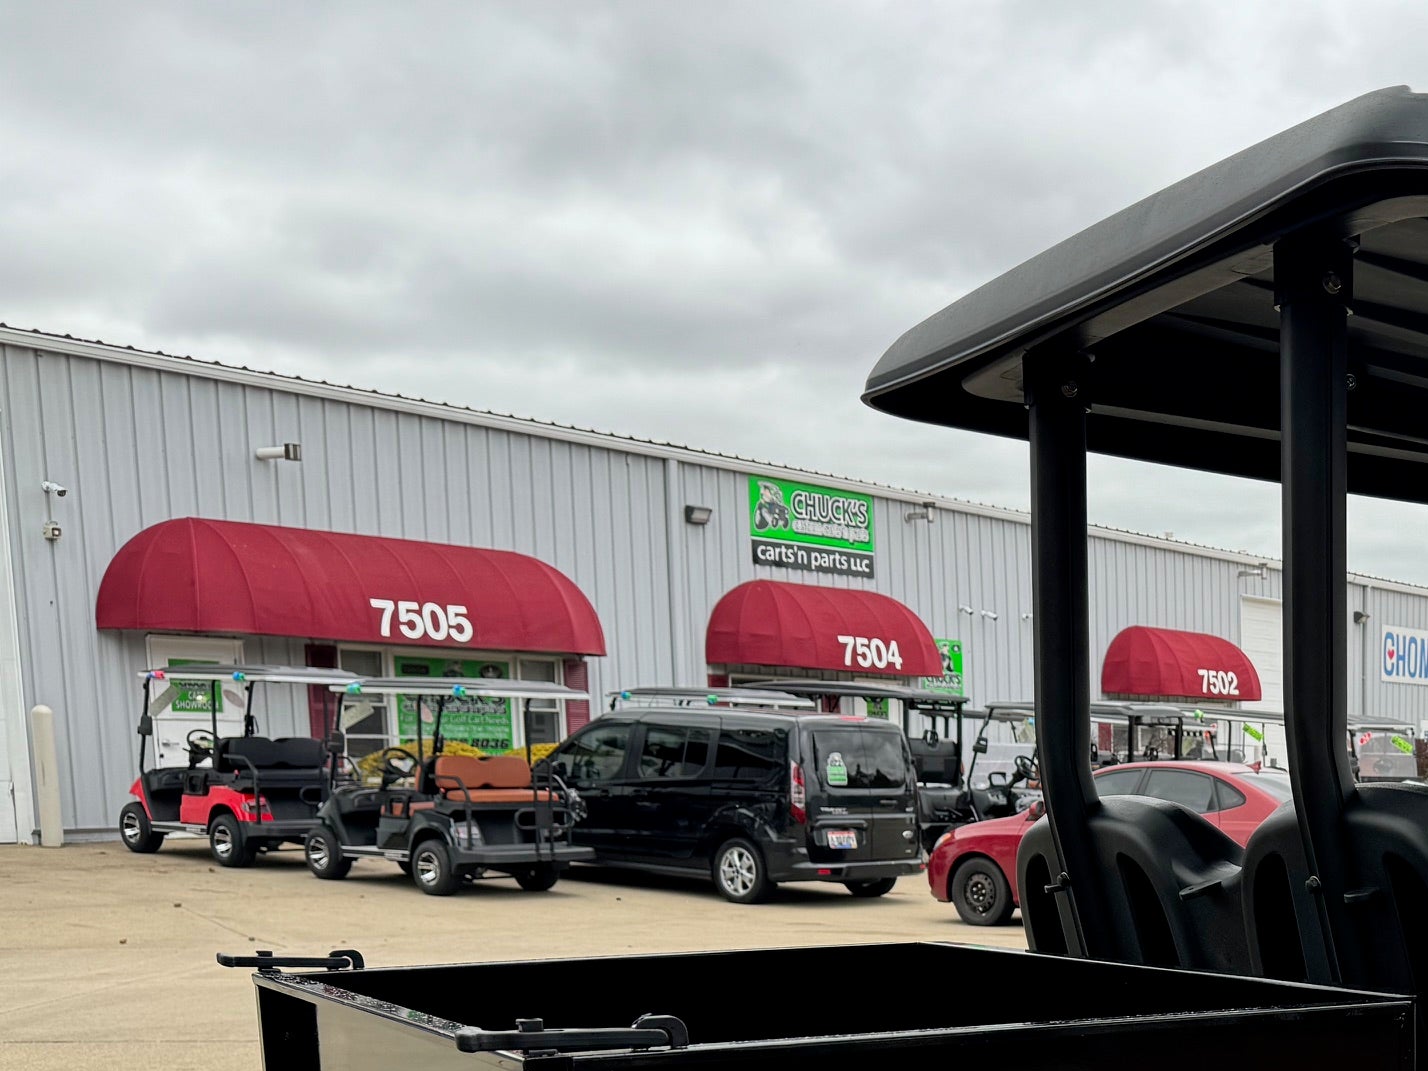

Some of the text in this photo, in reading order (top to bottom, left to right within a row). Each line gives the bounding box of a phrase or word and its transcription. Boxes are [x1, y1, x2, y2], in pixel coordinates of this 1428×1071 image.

[791, 491, 868, 528] CHUCK'S
[757, 545, 870, 572] carts'n parts LLC
[369, 598, 473, 643] 7505
[837, 635, 903, 670] 7504
[1197, 668, 1240, 696] 7502
